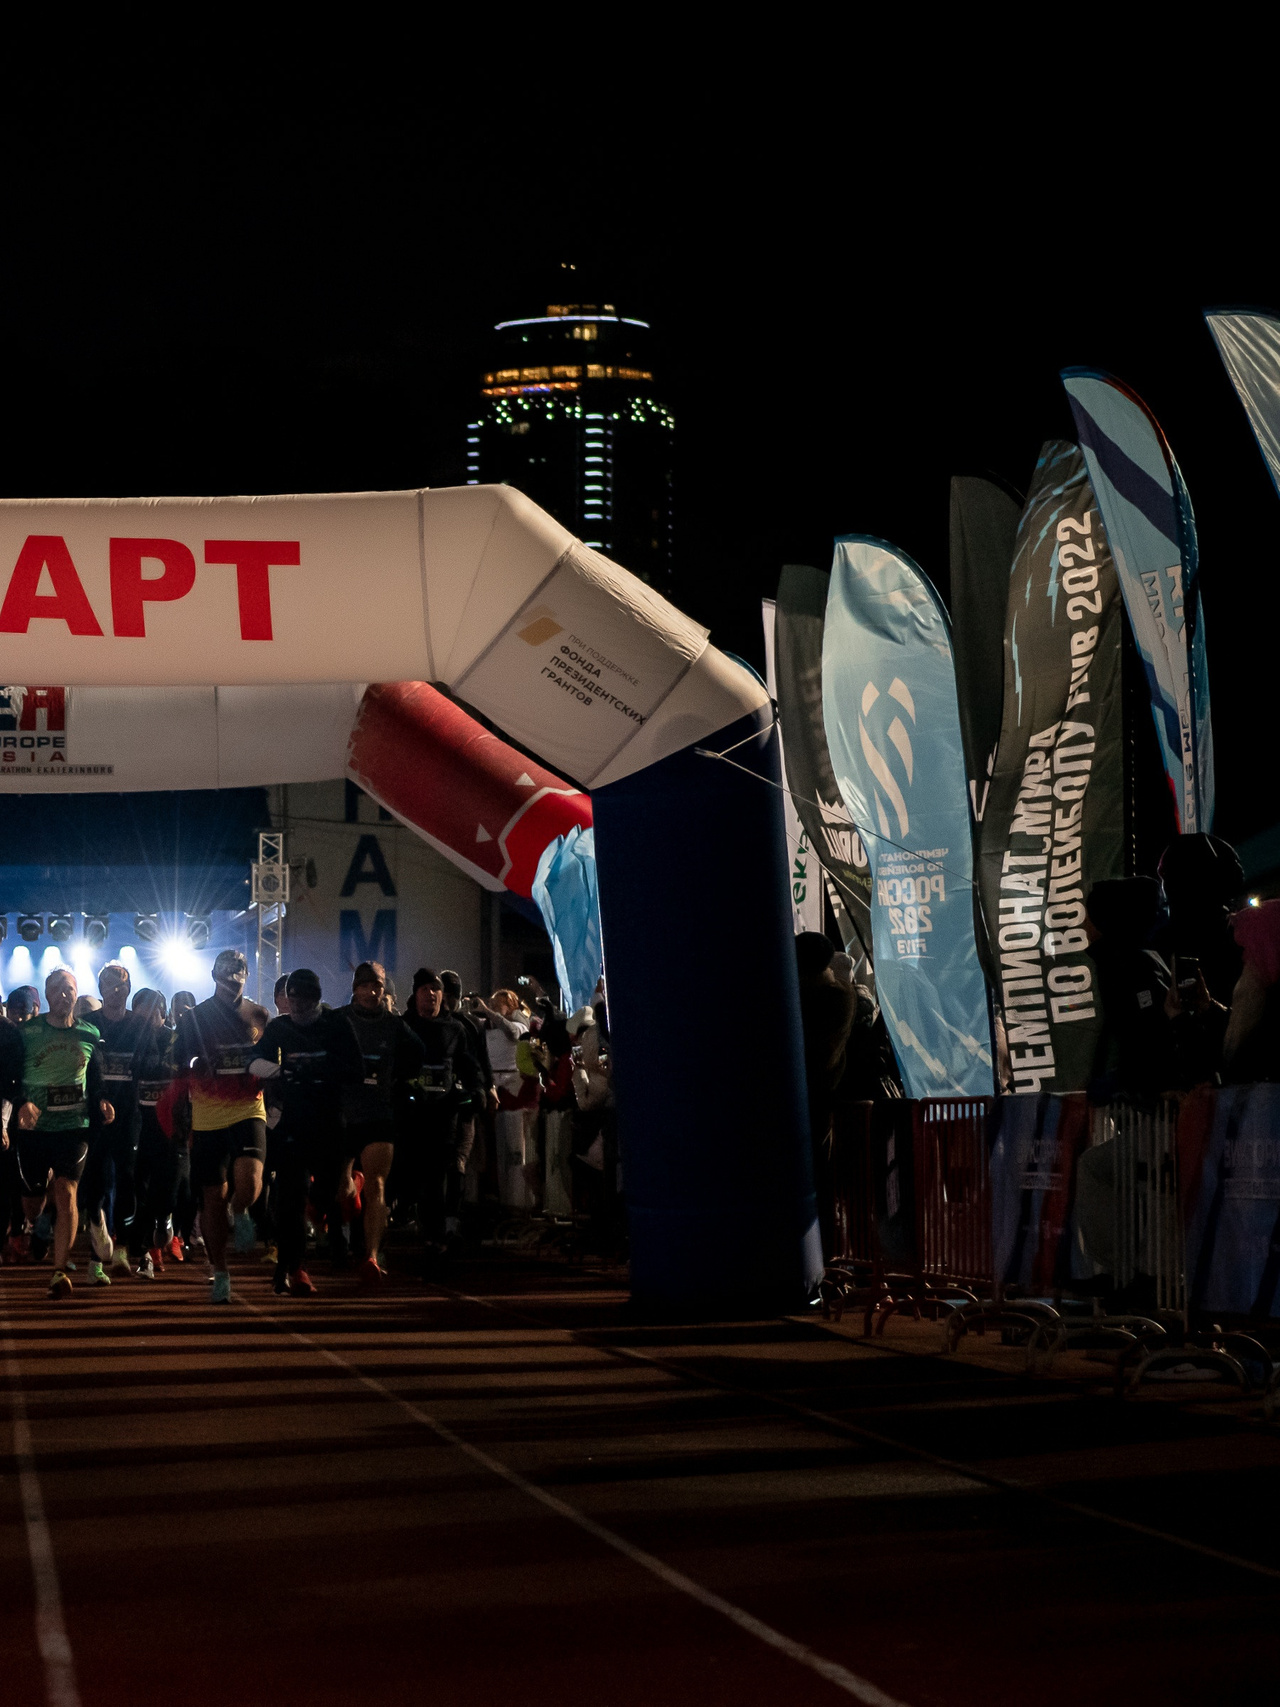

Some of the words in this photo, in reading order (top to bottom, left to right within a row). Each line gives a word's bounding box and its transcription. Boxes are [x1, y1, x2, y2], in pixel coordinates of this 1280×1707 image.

[1057, 510, 1101, 621] 2022
[541, 667, 593, 706] ГРАНТОВ
[560, 645, 601, 678] ФОНДА
[568, 634, 587, 649] ПРИ
[586, 647, 640, 687] ПОДДЕРЖКЕ
[550, 656, 647, 725] ПРЕЗИДЕНТСКИХ
[37, 766, 113, 774] EKATERINBURG
[1008, 720, 1061, 835] МИРА
[999, 846, 1056, 1094] ЧЕМПИОНАТ
[1047, 966, 1096, 1023] ПО
